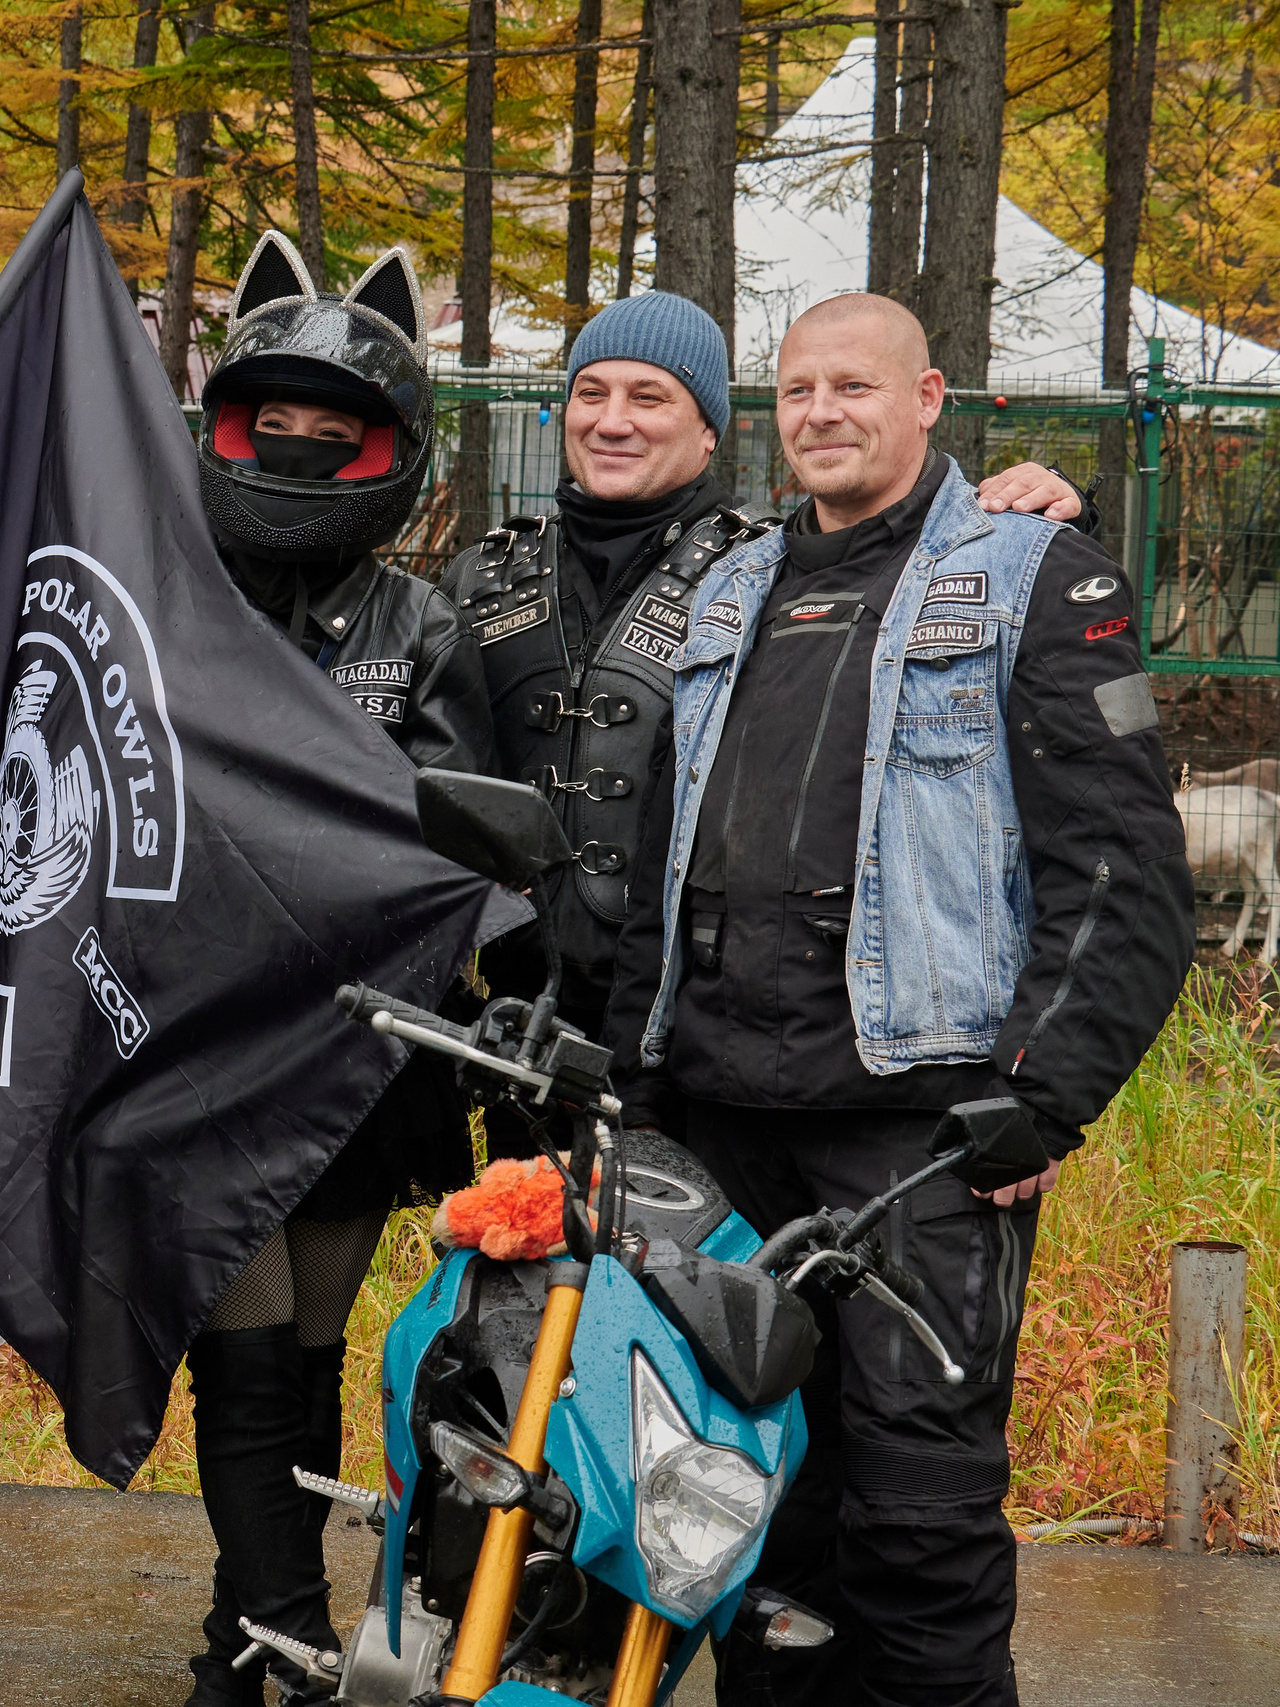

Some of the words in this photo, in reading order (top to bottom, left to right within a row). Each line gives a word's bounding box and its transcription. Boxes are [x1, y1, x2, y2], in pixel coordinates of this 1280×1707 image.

[926, 581, 976, 598] GADAN
[483, 607, 537, 638] MEMBER
[646, 603, 687, 630] MAGA
[628, 627, 681, 661] YAST
[909, 625, 974, 644] ECHANIC
[335, 663, 410, 685] MAGADAN
[22, 578, 111, 661] POLAR
[102, 663, 159, 858] OWLS
[80, 937, 143, 1046] MCC
